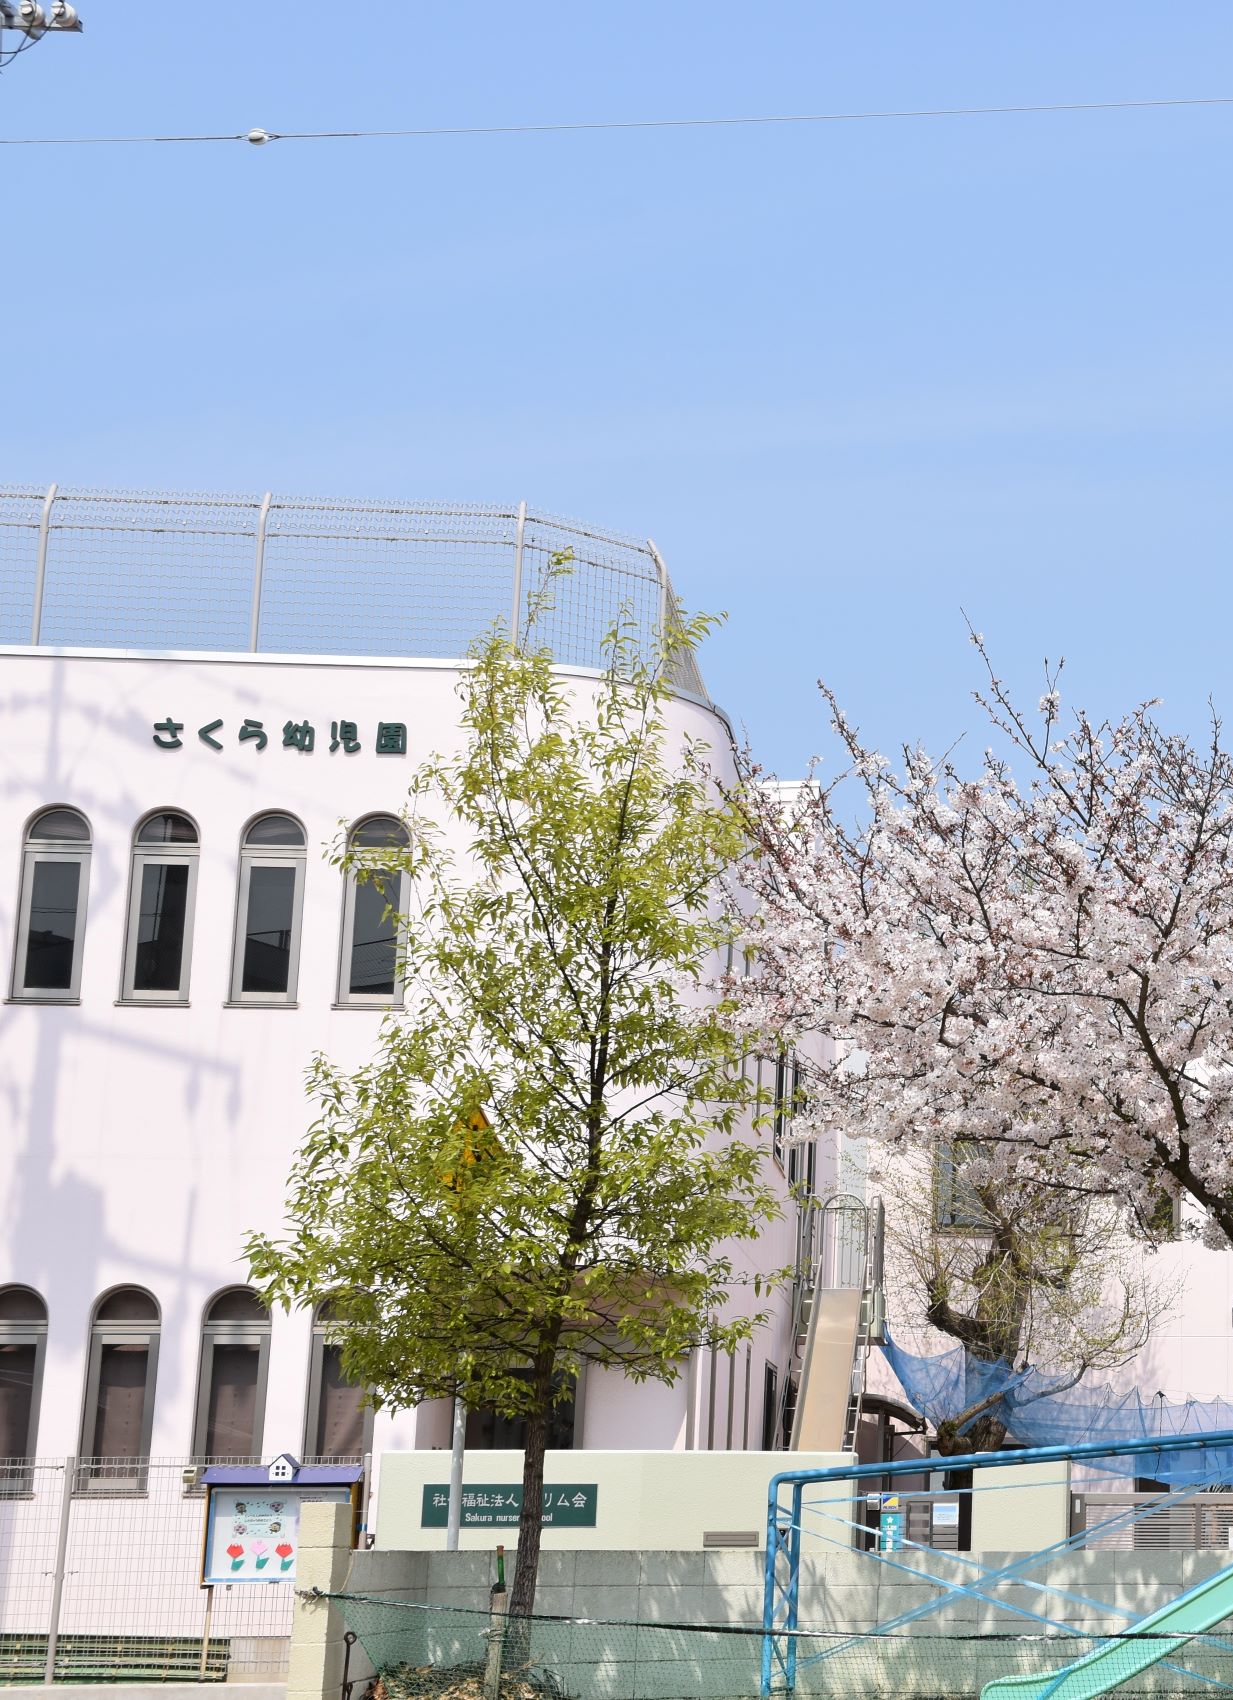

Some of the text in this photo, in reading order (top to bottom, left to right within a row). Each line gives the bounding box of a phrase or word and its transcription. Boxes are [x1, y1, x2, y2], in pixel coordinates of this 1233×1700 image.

[153, 717, 407, 754] さくら幼児園
[432, 1493, 519, 1508] 社福祉法人
[465, 1513, 493, 1522] Sakura
[496, 1513, 520, 1522] nurser
